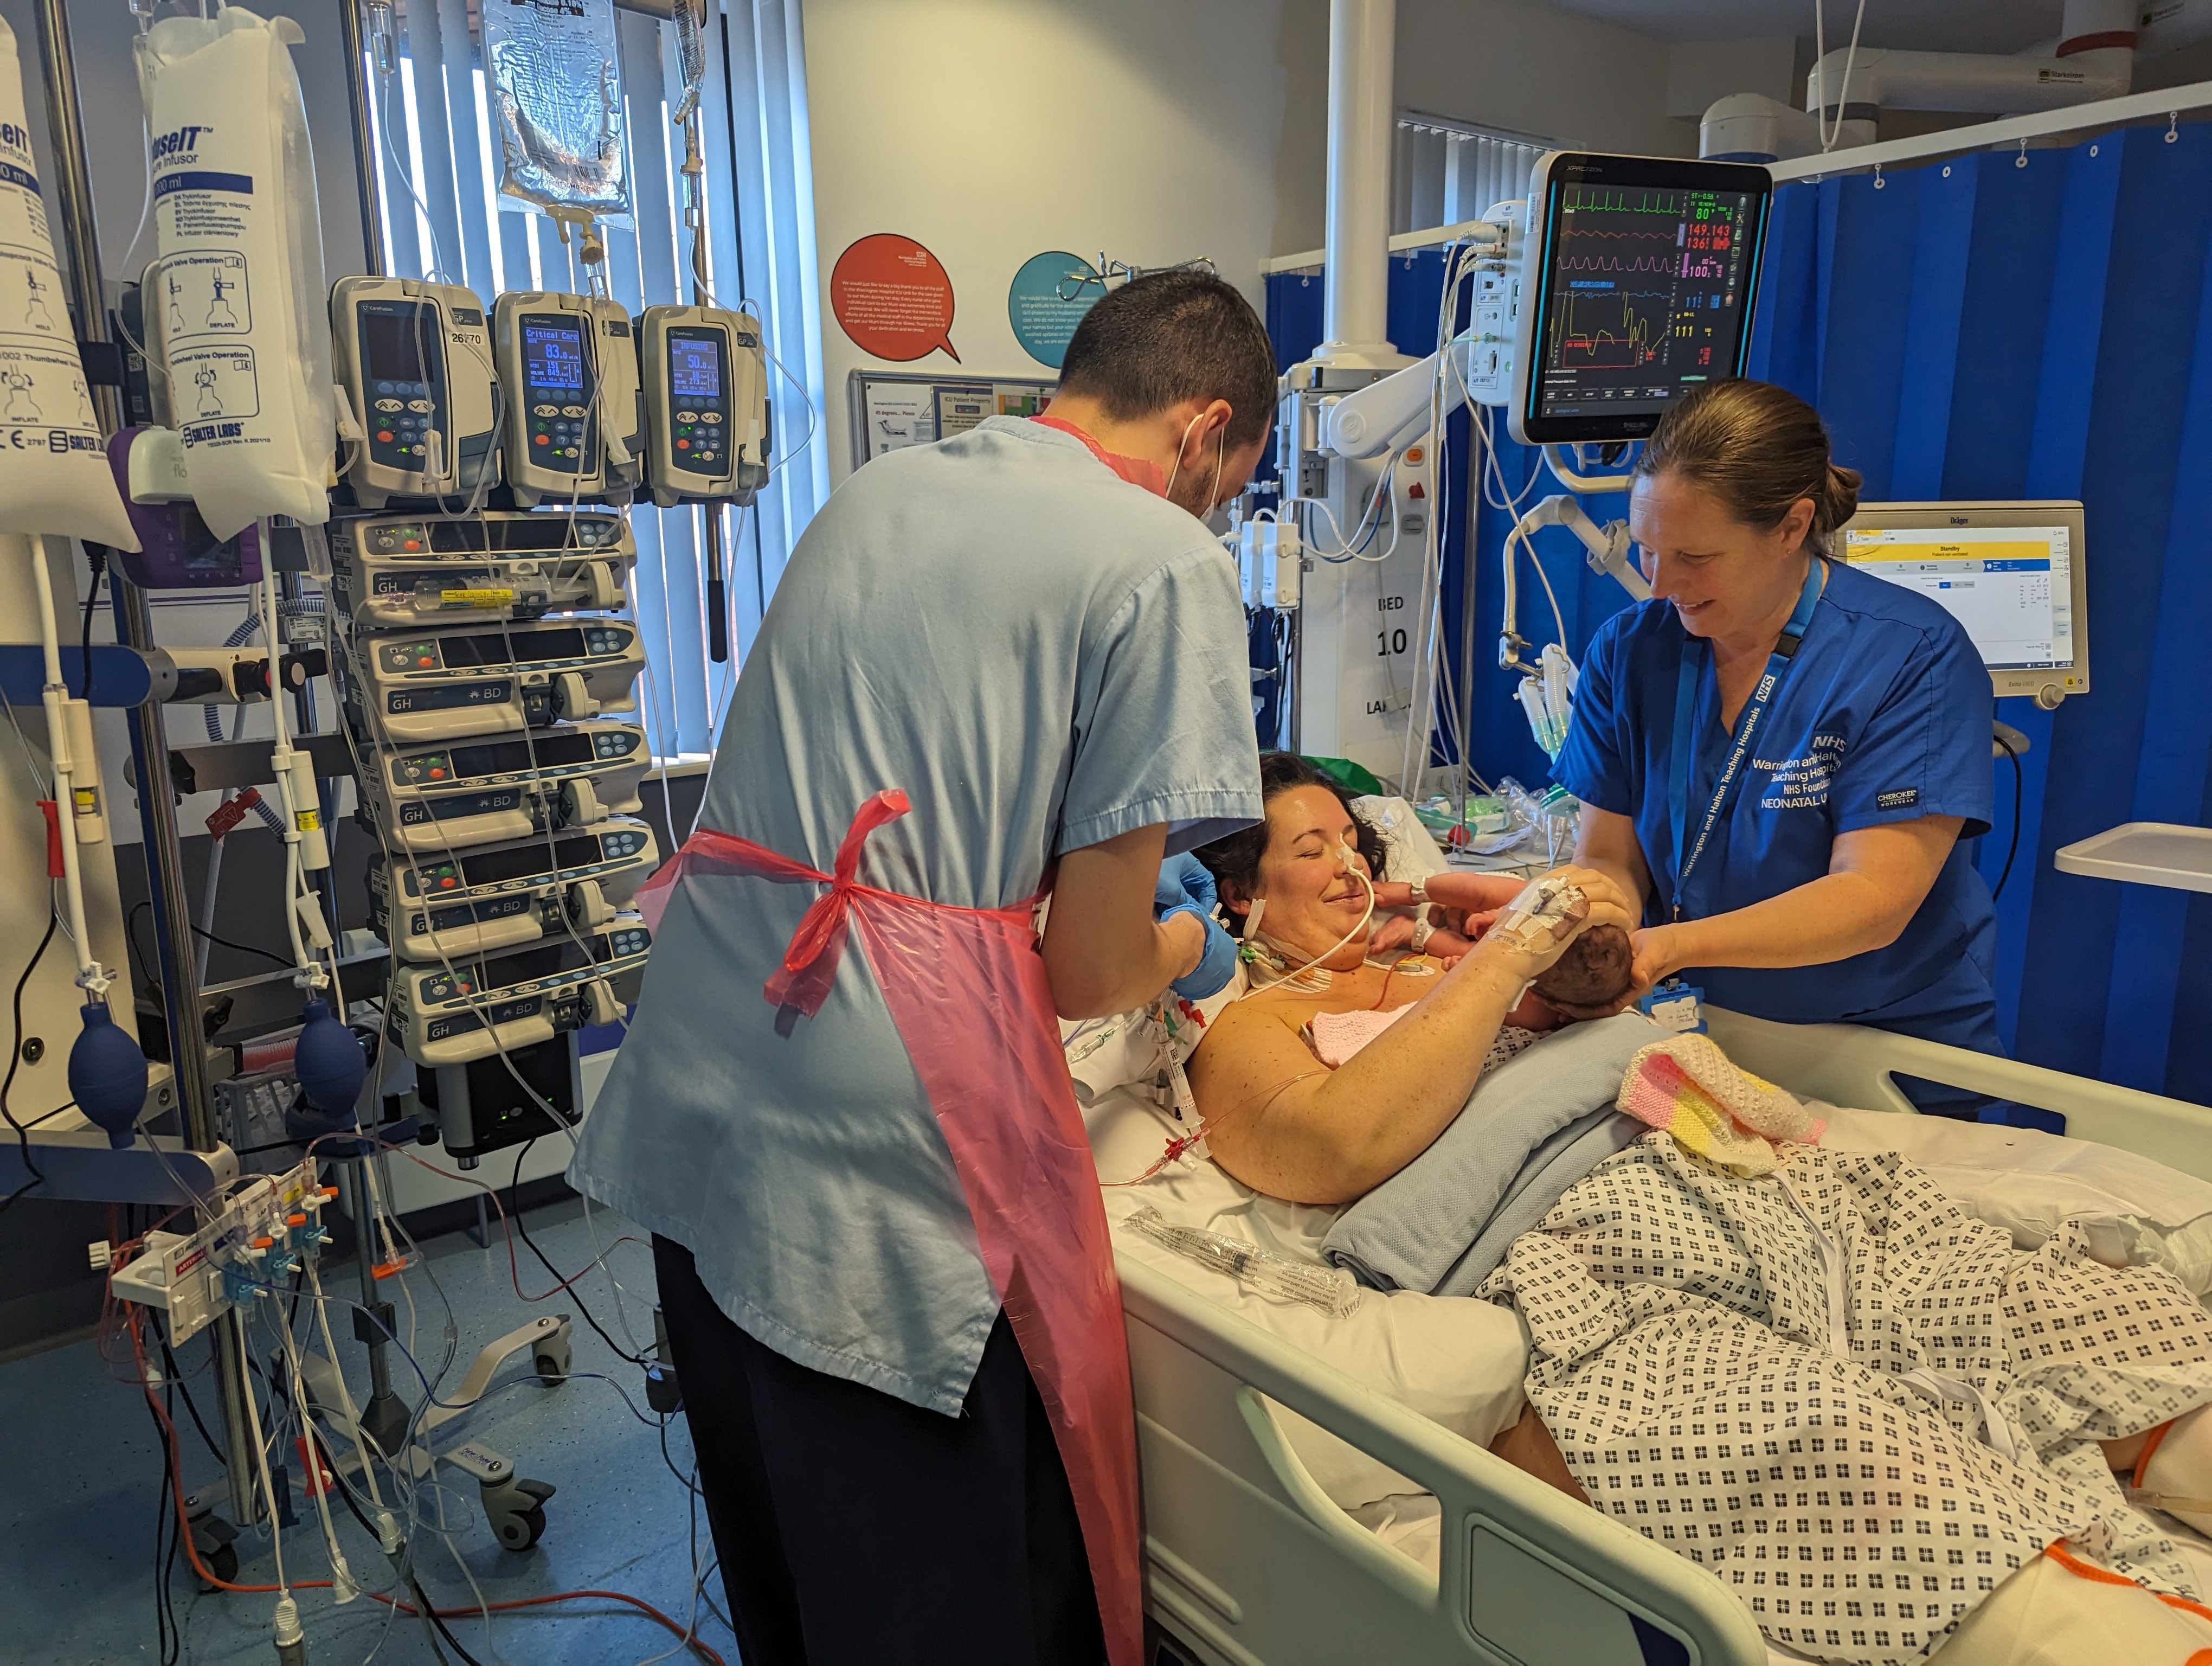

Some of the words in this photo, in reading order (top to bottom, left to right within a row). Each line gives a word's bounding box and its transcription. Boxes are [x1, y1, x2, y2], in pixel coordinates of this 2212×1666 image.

[536, 2, 558, 14] Gucose
[560, 5, 572, 15] 4%
[0, 123, 27, 153] eIT
[164, 154, 198, 168] Infusor
[169, 176, 182, 188] ml
[1696, 208, 1709, 220] 80
[1687, 237, 1705, 249] 136
[526, 329, 558, 339] Critical
[562, 332, 578, 340] Care
[1675, 325, 1694, 337] 111
[545, 344, 568, 360] 83.0
[680, 342, 708, 351] INFUSING
[547, 361, 558, 369] 151
[687, 354, 707, 369] 50.0
[192, 425, 217, 443] SALTER
[217, 422, 242, 438] LABS
[1950, 517, 1968, 525] Dräger
[378, 582, 397, 593] GH
[1378, 597, 1403, 612] BED
[1377, 629, 1407, 657] 10
[484, 688, 501, 699] BD
[1756, 676, 1774, 701] NHS
[393, 699, 411, 710] GH
[1738, 707, 1760, 747] Hospitals
[1813, 736, 1847, 752] NHS
[1721, 747, 1745, 783] Teaching
[1783, 784, 1801, 794] NHS
[493, 796, 511, 807] BD
[1709, 785, 1727, 813] Halton
[1877, 790, 1915, 802] CHEROKEE
[1761, 797, 1820, 809] NEONATAL
[1881, 798, 1914, 807] WORKWEAR
[404, 810, 423, 822] GH
[1705, 814, 1715, 831] and
[1683, 832, 1707, 877] Warrington
[503, 901, 520, 912] BD
[516, 1002, 533, 1014] BD
[432, 1026, 449, 1037] GH
[258, 1208, 267, 1218] LAP
[178, 1248, 203, 1273] ARTERIAL
